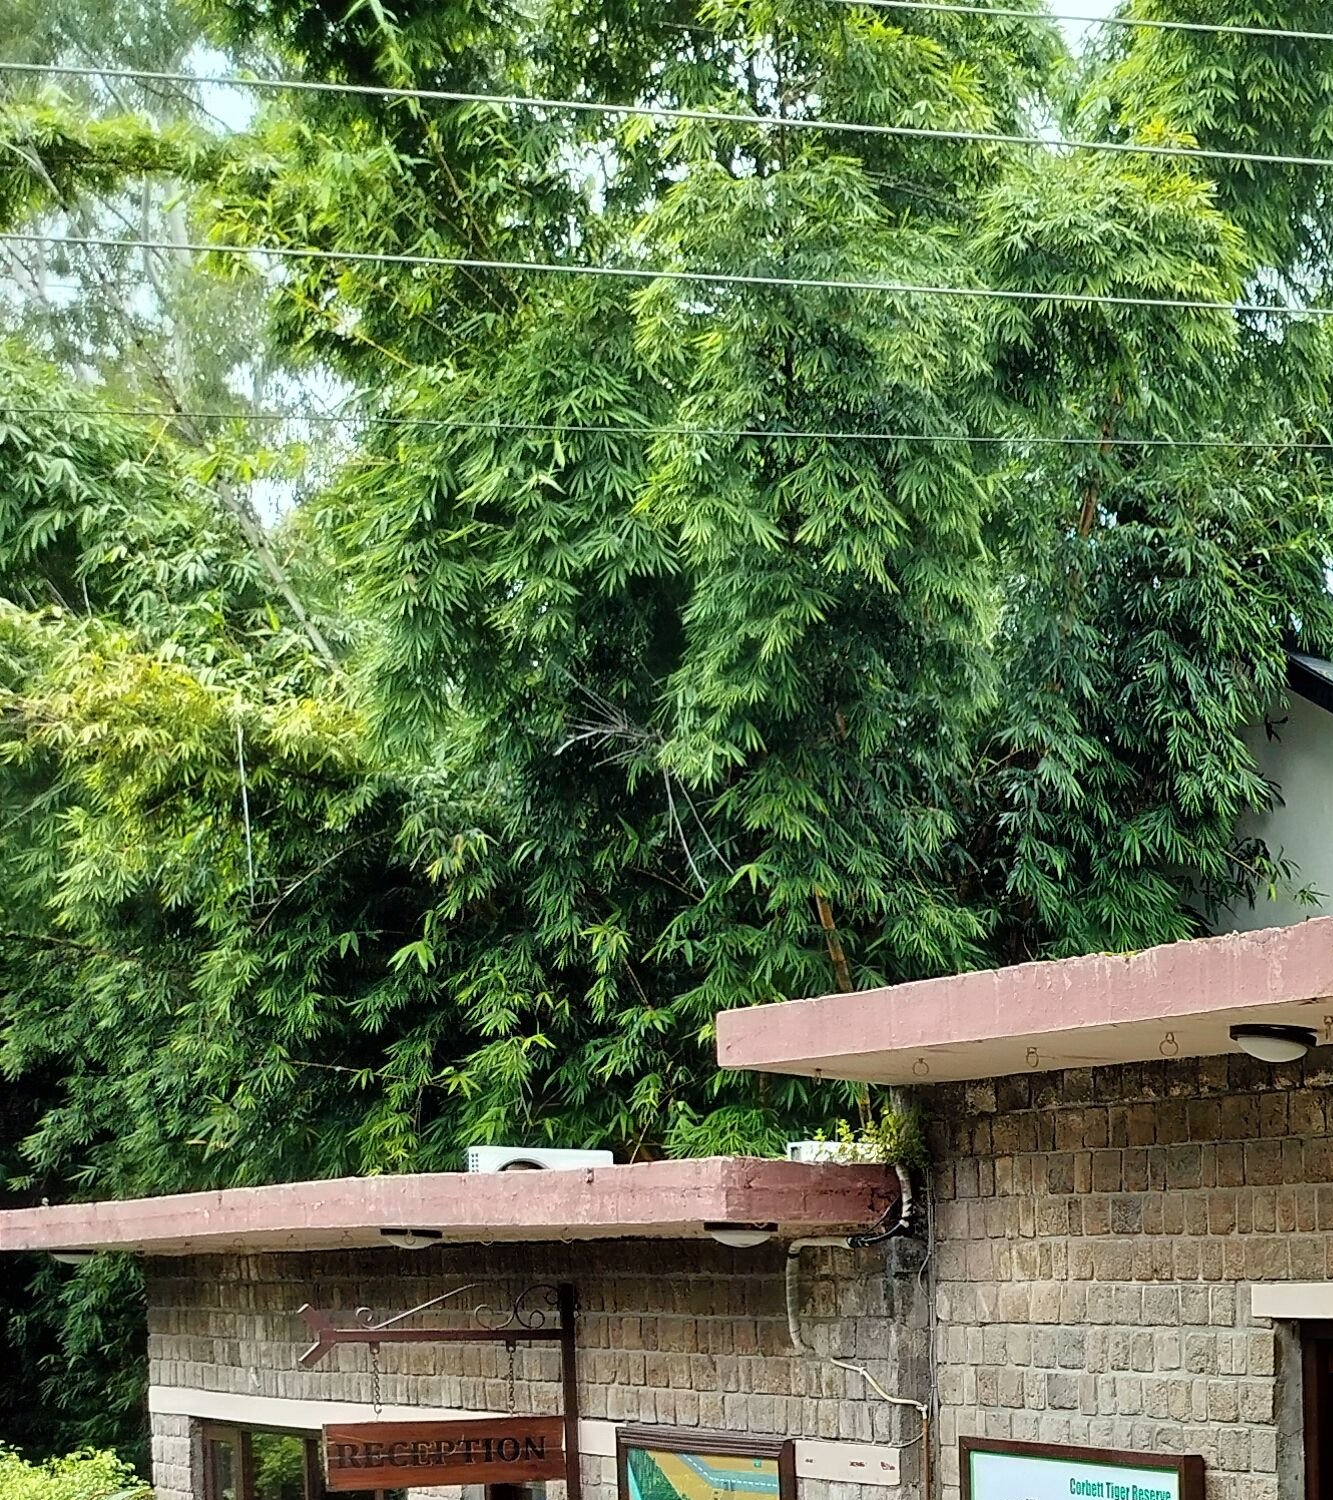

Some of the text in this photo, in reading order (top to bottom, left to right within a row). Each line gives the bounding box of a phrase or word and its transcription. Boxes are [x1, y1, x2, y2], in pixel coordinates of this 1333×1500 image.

[336, 1435, 546, 1468] RECEPTION
[1069, 1477, 1105, 1499] Corbett
[1105, 1481, 1130, 1500] Tiger
